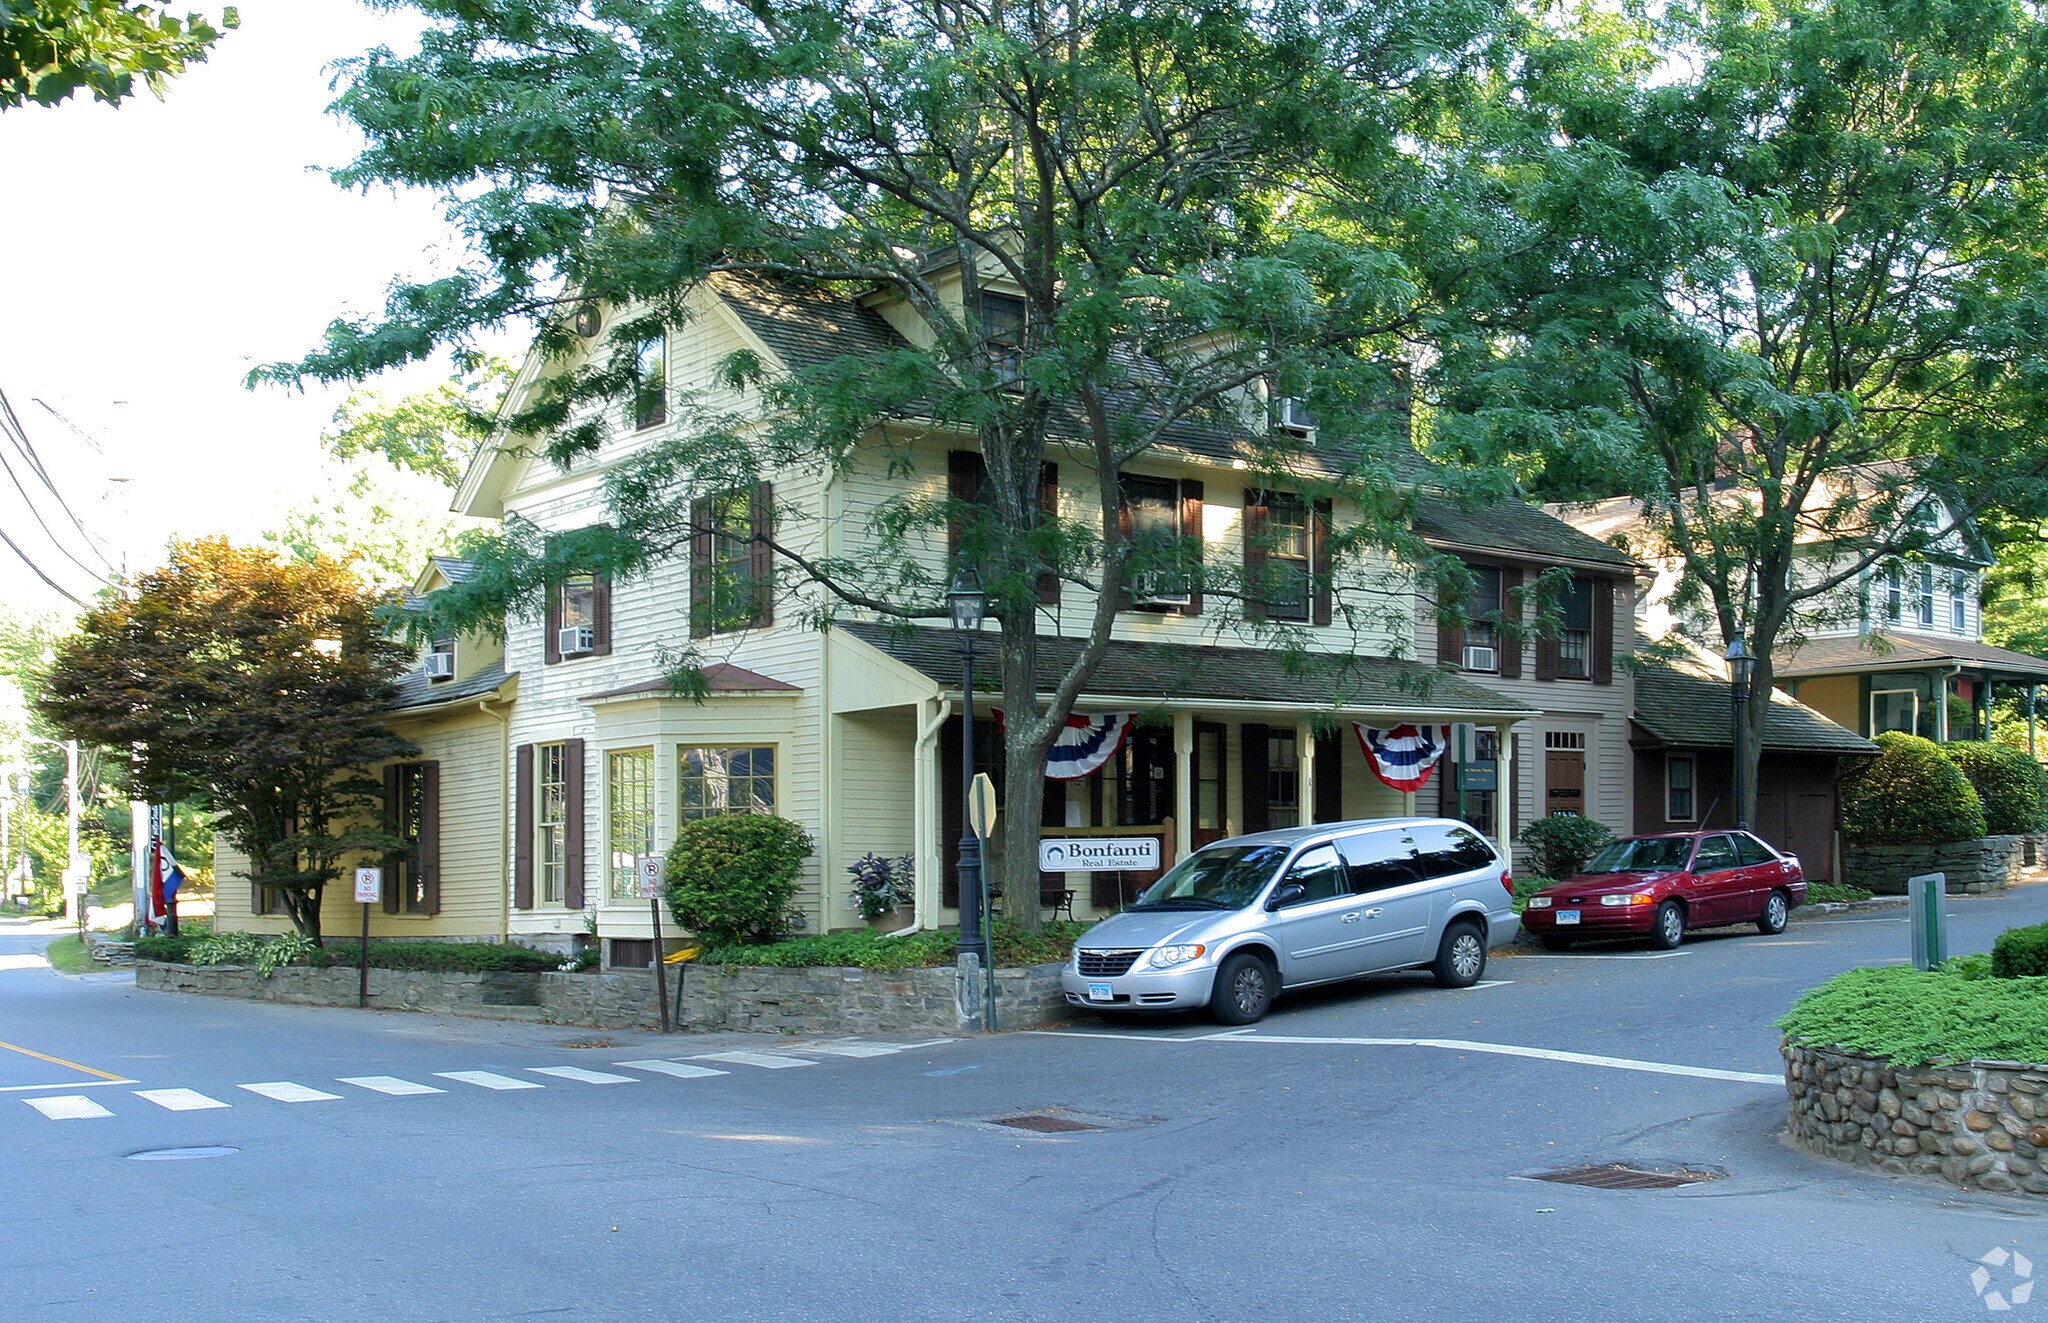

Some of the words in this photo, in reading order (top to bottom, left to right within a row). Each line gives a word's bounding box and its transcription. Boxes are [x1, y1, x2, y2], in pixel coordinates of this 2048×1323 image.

[1069, 843, 1150, 857] Bonfanti
[1082, 859, 1103, 867] Real
[1108, 859, 1138, 867] Estate
[648, 878, 657, 886] NO
